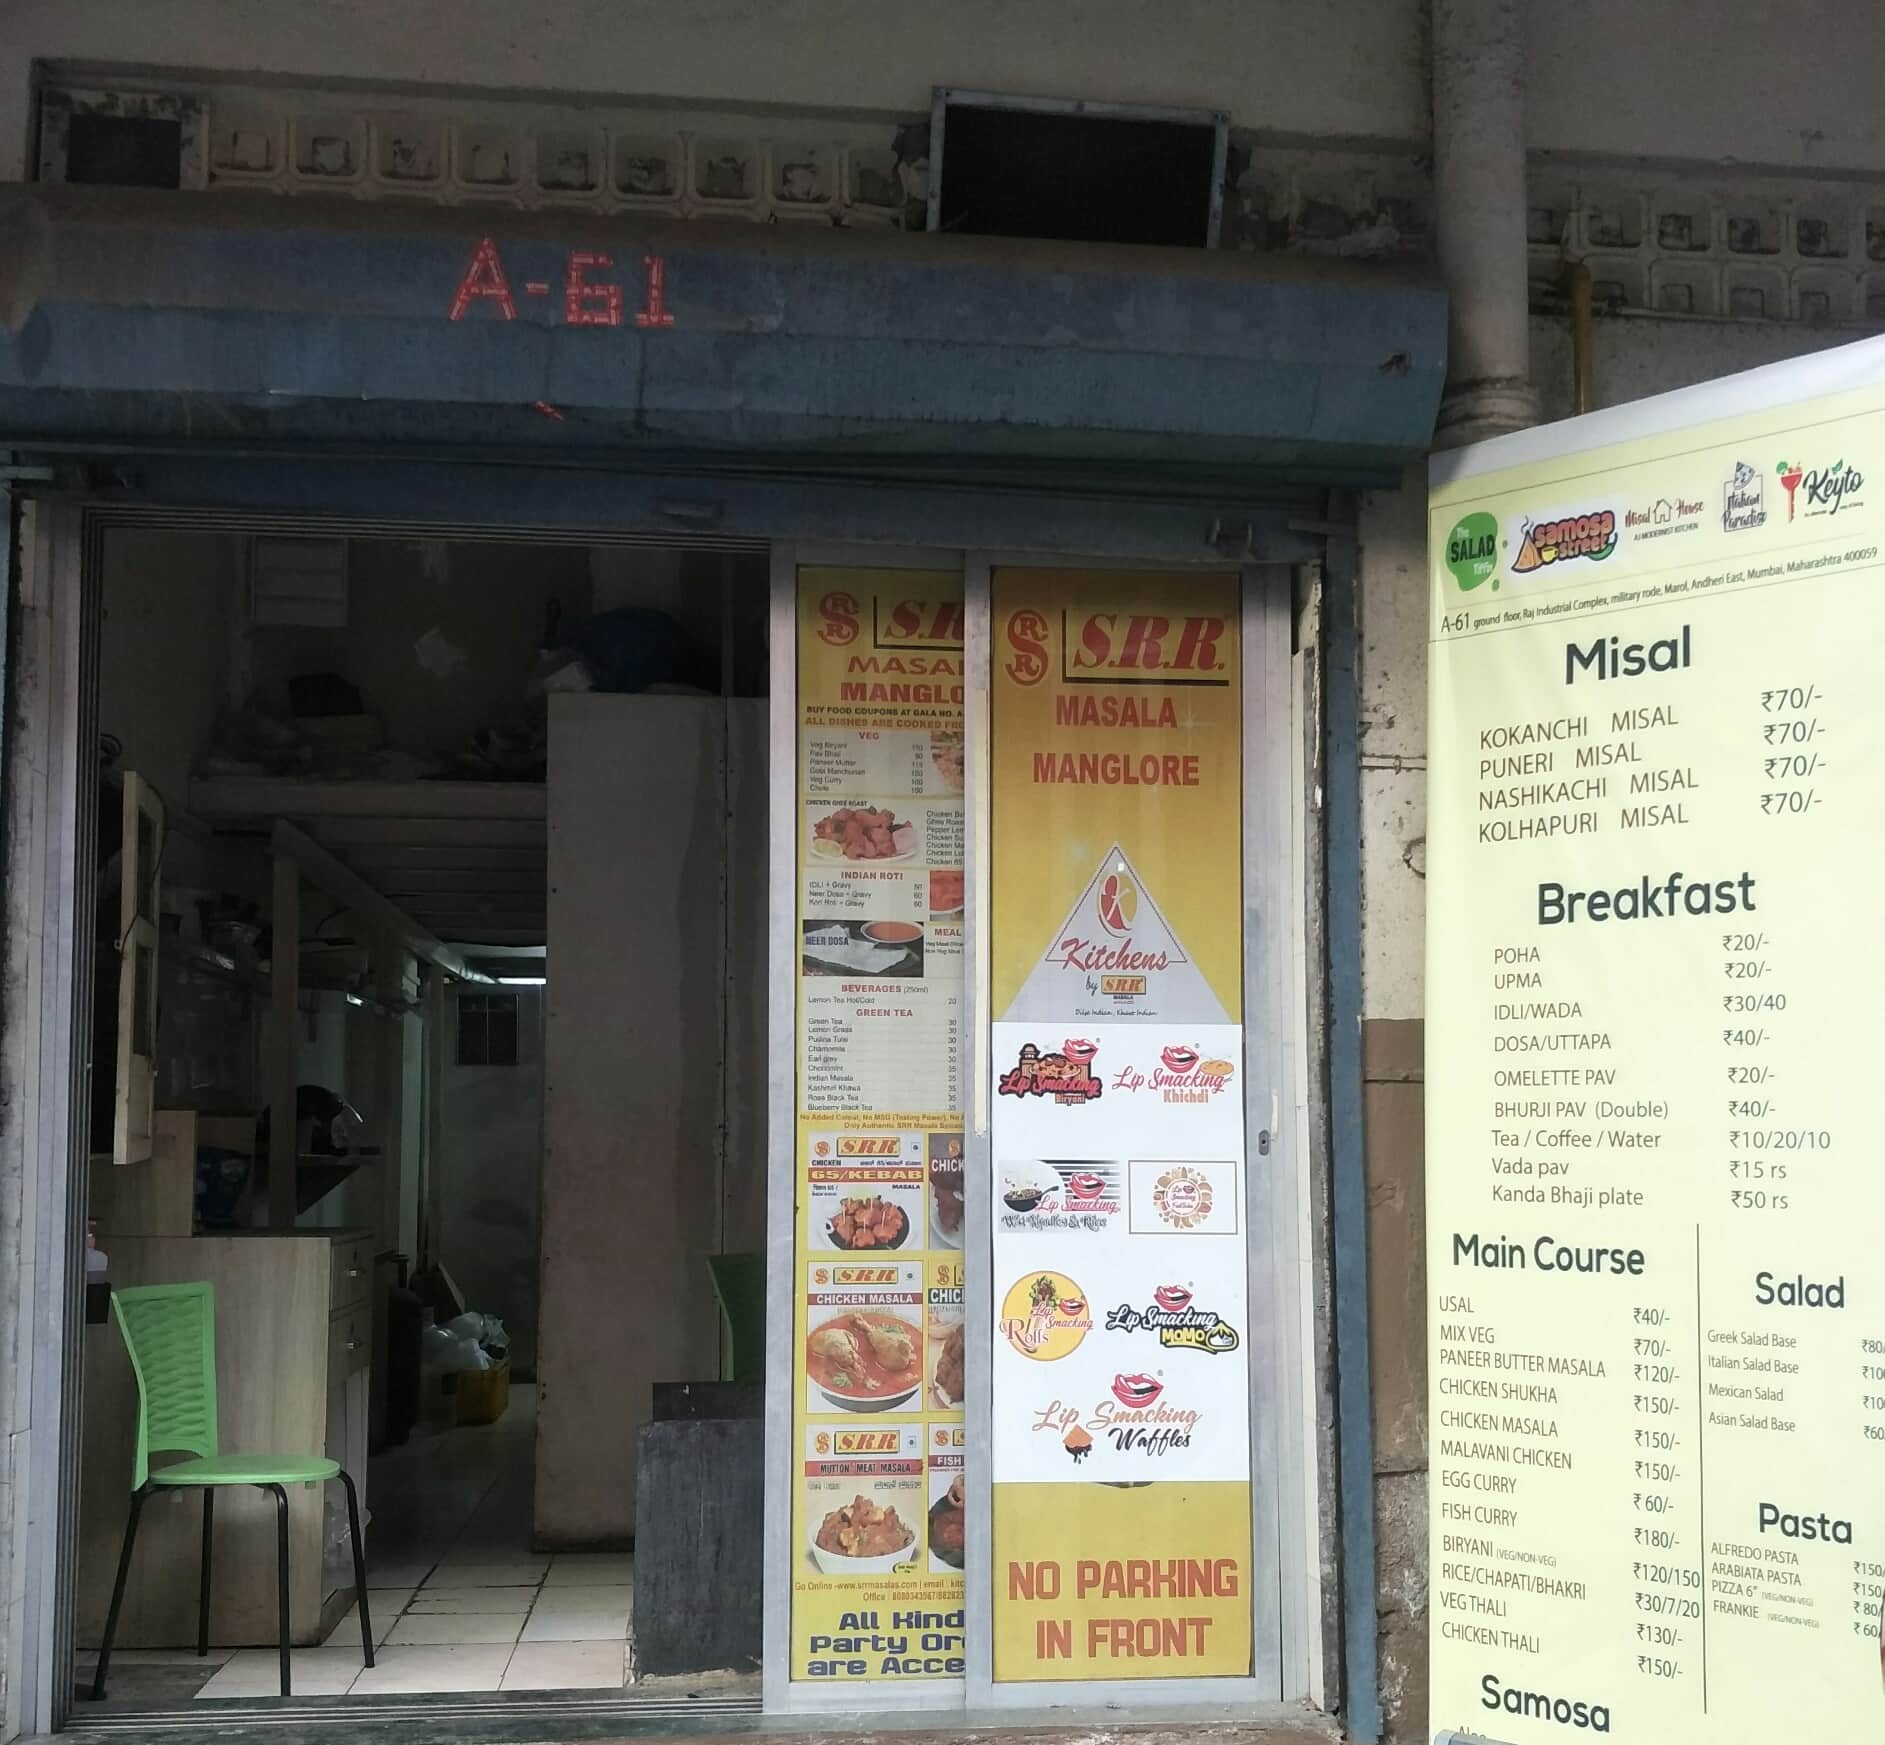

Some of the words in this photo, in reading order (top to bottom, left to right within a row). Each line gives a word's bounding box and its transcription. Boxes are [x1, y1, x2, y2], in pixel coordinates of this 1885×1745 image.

[448, 233, 675, 327] A-61
[1803, 465, 1864, 515] Keyto
[1451, 534, 1495, 563] SALAD
[1441, 613, 1469, 633] A-61
[1474, 613, 1500, 630] ground
[1523, 608, 1534, 620] Raj
[1537, 600, 1571, 616] Industrial
[1573, 594, 1609, 611] Complex,
[1611, 588, 1641, 605] military
[1691, 573, 1723, 591] Andheri
[1787, 555, 1842, 573] Maharashtra
[1844, 547, 1877, 562] 400059
[849, 655, 964, 676] MASA
[1565, 624, 1691, 685] Misal
[806, 706, 823, 714] BUY
[827, 706, 852, 715] FOOD
[855, 707, 898, 716] COUPONS
[1055, 695, 1178, 728] MASALA
[1480, 715, 1588, 751] KOKANCHI
[1611, 704, 1679, 733] MISAL
[1760, 684, 1823, 713] ₹70/-
[858, 731, 880, 741] VEG
[1479, 752, 1554, 780] PUNERI
[1575, 741, 1642, 769] MISAL
[1763, 718, 1825, 746] ₹70/-
[1033, 752, 1200, 786] MANGLORE
[1479, 777, 1607, 812] NASHIKACHI
[1630, 767, 1699, 795] MISAL
[1763, 753, 1826, 780] ₹70/-
[1479, 812, 1598, 843] KOLHAPURI
[1620, 802, 1689, 830] MISAL
[1760, 788, 1823, 816] ₹70/-
[841, 871, 877, 880] INDIAN
[880, 872, 904, 881] ROTI
[1537, 871, 1757, 925] Breakfast
[828, 936, 849, 946] DOSA
[934, 928, 962, 937] MEAL
[1060, 937, 1169, 972] Kitchens
[1494, 946, 1541, 964] POHA
[841, 984, 902, 993] BEVERAGES
[1494, 972, 1542, 990] UPMA
[856, 1009, 891, 1017] GREEN
[894, 1009, 913, 1017] TEA
[1493, 1002, 1583, 1021] IDLI/WADA
[1723, 994, 1787, 1013] ₹30/40
[1494, 1033, 1612, 1052] DOSA/UTTAPA
[1112, 1065, 1145, 1092] Lip
[1148, 1067, 1232, 1092] Smacking
[1494, 1069, 1581, 1087] OMELETTE
[1585, 1068, 1617, 1086] PAV
[1164, 1088, 1209, 1103] Khichdi
[1494, 1101, 1551, 1119] BHURJI
[1555, 1102, 1586, 1118] PAV
[1595, 1100, 1669, 1120] (Double)
[1491, 1130, 1520, 1149] Tea
[1535, 1129, 1592, 1149] Coffee
[1607, 1131, 1662, 1149] Water
[1729, 1130, 1831, 1151] ₹10/20/10
[1491, 1157, 1533, 1176] Vada
[1538, 1161, 1570, 1179] pav
[1492, 1185, 1546, 1203] Kanda
[1550, 1186, 1594, 1209] Bhaji
[1598, 1187, 1644, 1208] plate
[1452, 1232, 1526, 1270] Main
[1533, 1235, 1646, 1276] Course
[817, 1295, 865, 1304] CHICKEN
[869, 1295, 913, 1303] MASALA
[1754, 1271, 1845, 1309] Salad
[1439, 1295, 1475, 1313] USAL
[1107, 1306, 1141, 1327] Lip
[1143, 1309, 1218, 1329] Smacking
[1440, 1324, 1466, 1342] MIX
[1469, 1327, 1495, 1344] VEG
[1707, 1330, 1738, 1344] Greek
[1740, 1331, 1769, 1347] Salad
[1772, 1333, 1796, 1348] Base
[1440, 1349, 1491, 1368] PANEER
[1494, 1353, 1544, 1372] BUTTER
[1548, 1356, 1606, 1378] MASALA
[1708, 1355, 1740, 1369] Italian
[1743, 1357, 1771, 1372] Salad
[1774, 1359, 1799, 1374] Base
[1439, 1377, 1498, 1398] CHICKEN
[1501, 1382, 1557, 1404] SHUKHA
[1708, 1383, 1752, 1399] Mexican
[1755, 1386, 1784, 1401] Salad
[1032, 1399, 1081, 1431] Lip
[1086, 1401, 1203, 1436] Smacking
[1440, 1410, 1499, 1431] CHICKEN
[1502, 1415, 1558, 1437] MASALA
[1708, 1411, 1736, 1427] Asian
[1740, 1414, 1768, 1429] Salad
[1771, 1417, 1796, 1432] Base
[1107, 1427, 1192, 1457] Waffles
[937, 1456, 961, 1465] FISH
[1441, 1439, 1509, 1462] MALAVANI
[1513, 1447, 1572, 1470] CHICKEN
[1442, 1470, 1471, 1489] EGG
[1474, 1473, 1517, 1494] CURRY
[1442, 1502, 1471, 1521] FISH
[1474, 1506, 1517, 1527] CURRY
[1759, 1502, 1852, 1544] Pasta
[1443, 1535, 1493, 1557] BIRYANI
[1633, 1562, 1700, 1588] ₹120/150
[1711, 1542, 1762, 1560] ALFREDO
[1764, 1549, 1799, 1565] PASTA
[1008, 1561, 1061, 1601] NO
[1076, 1558, 1239, 1599] PARKING
[1711, 1562, 1764, 1581] ARABIATA
[1767, 1569, 1802, 1586] PASTA
[1442, 1562, 1586, 1601] RICE/CHAPATI/BHAKRI
[1635, 1592, 1700, 1618] ₹30/7/20
[1712, 1579, 1743, 1596] PIZZA
[1440, 1590, 1466, 1610] VEG
[1469, 1594, 1506, 1617] THALI
[1713, 1600, 1760, 1618] FRANKIE
[839, 1611, 880, 1631] All
[810, 1634, 908, 1655] Party
[1036, 1619, 1072, 1659] IN
[1087, 1617, 1213, 1658] FRONT
[1442, 1621, 1499, 1646] CHICKEN
[1501, 1631, 1540, 1654] THALI
[808, 1658, 867, 1676] are
[1481, 1674, 1610, 1733] Samosa
